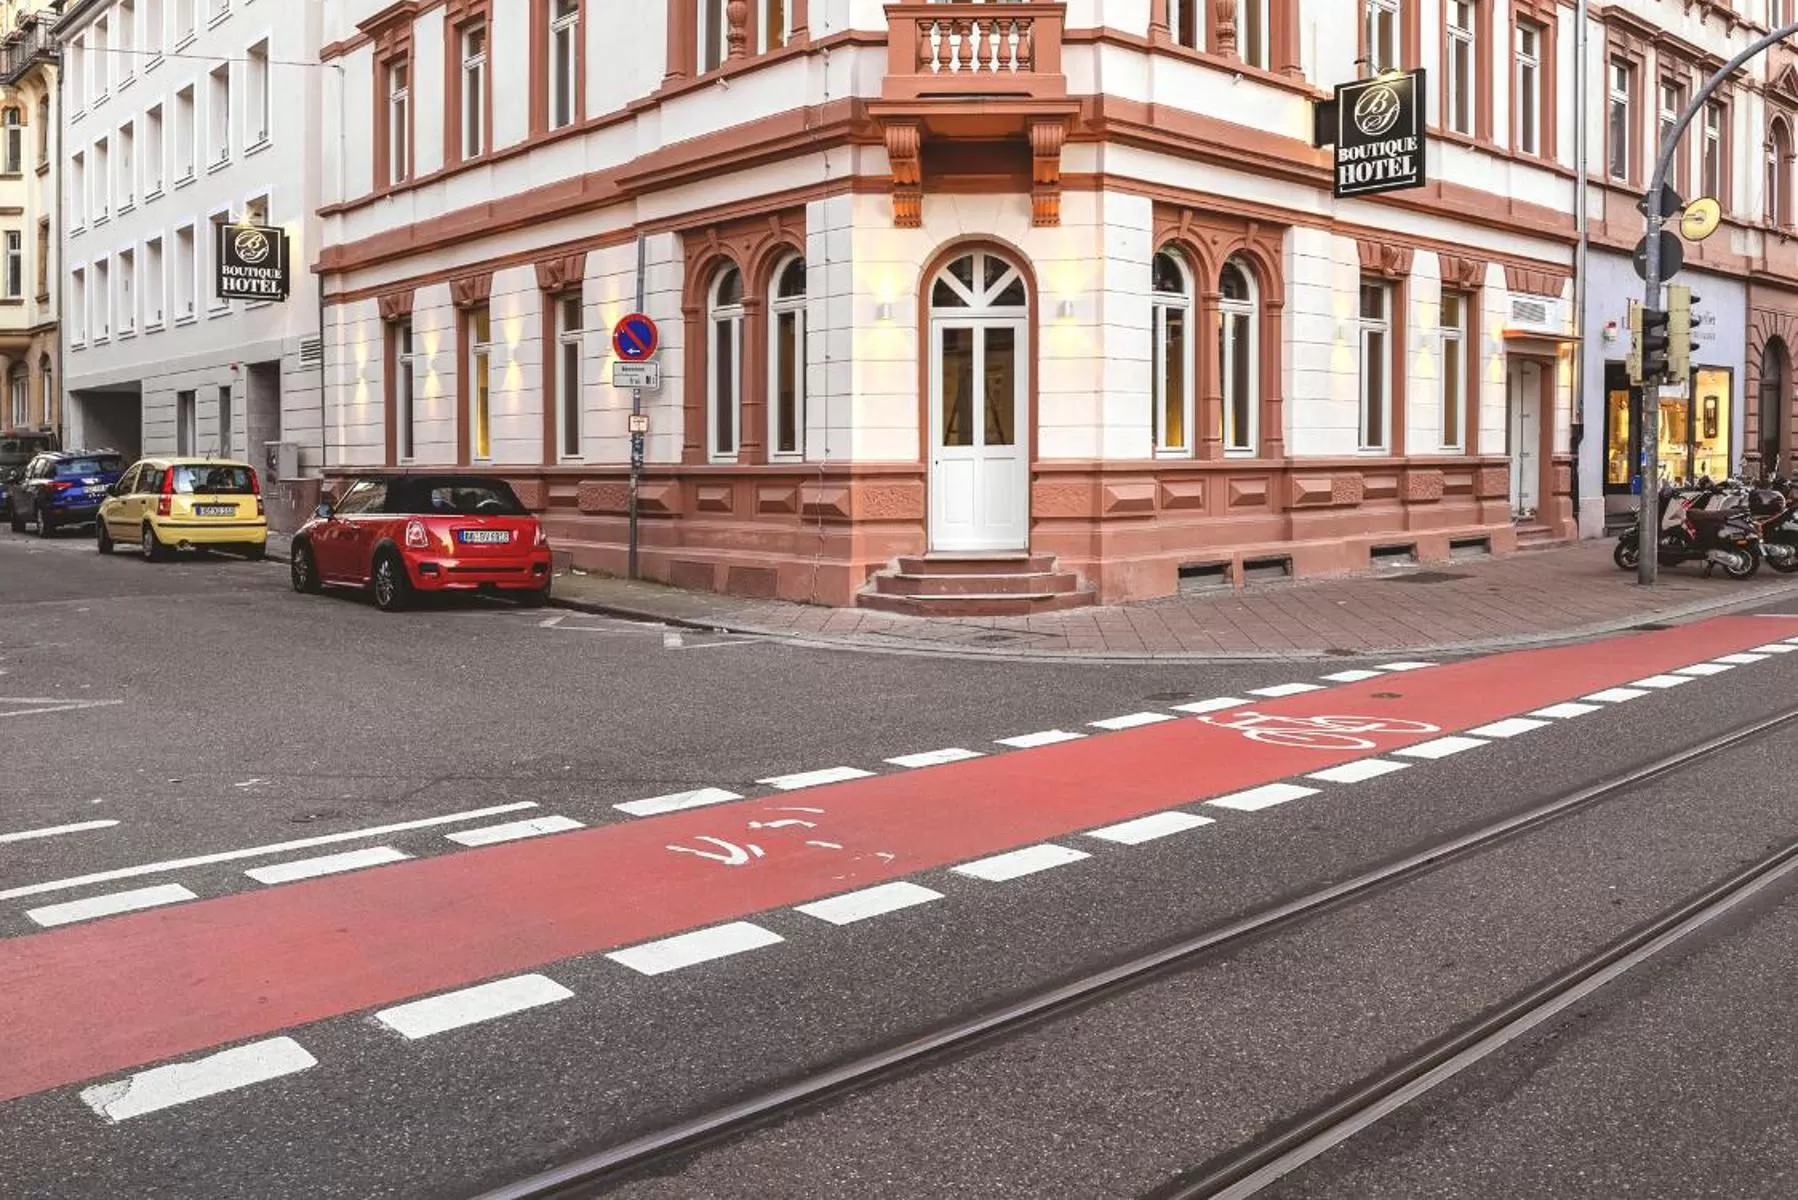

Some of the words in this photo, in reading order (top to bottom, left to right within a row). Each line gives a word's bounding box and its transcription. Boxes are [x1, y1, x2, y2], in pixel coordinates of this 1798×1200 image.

[1338, 136, 1417, 161] BOUTIQUE
[1338, 155, 1416, 185] HOTEL
[222, 265, 282, 279] BOUTIQUE
[222, 277, 282, 293] HOTEL
